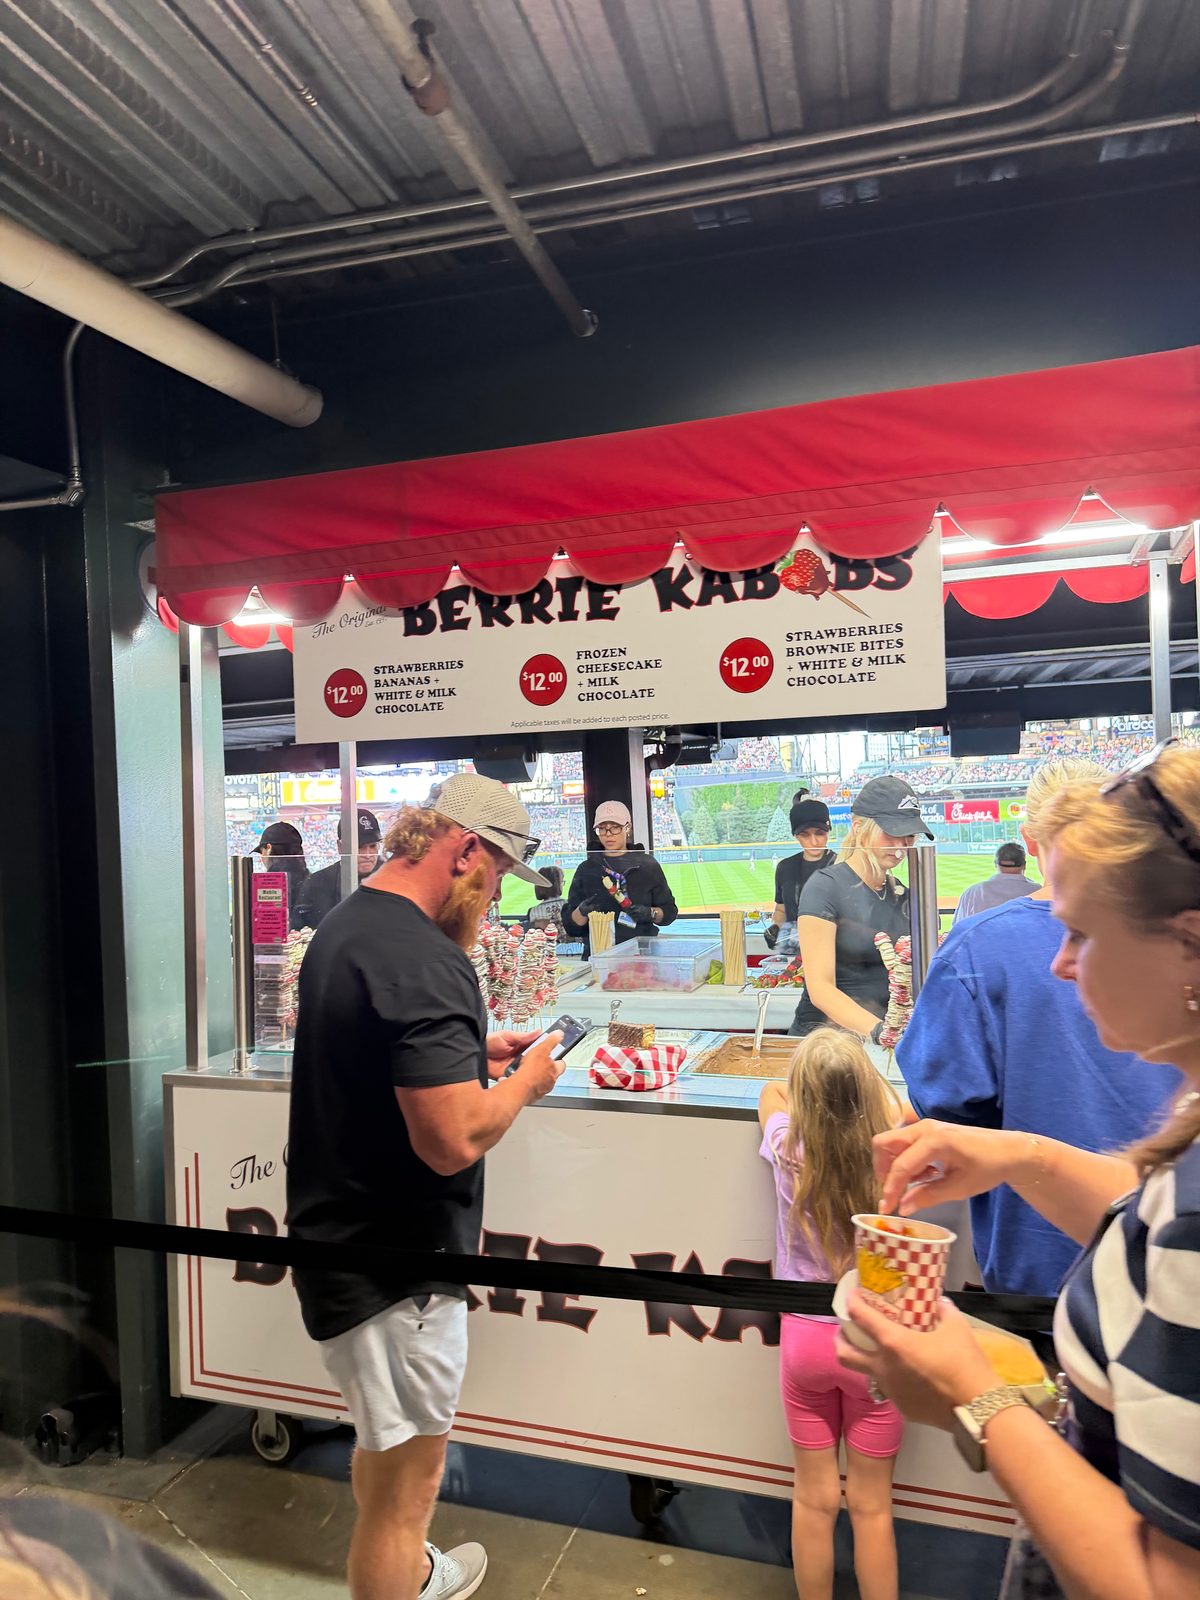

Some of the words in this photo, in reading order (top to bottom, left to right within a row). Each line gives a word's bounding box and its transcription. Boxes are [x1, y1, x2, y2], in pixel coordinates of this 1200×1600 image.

[398, 576, 624, 637] BERRIE
[312, 621, 335, 638] The
[785, 622, 904, 642] STRAWBERRIES
[576, 647, 627, 660] FROZEN
[786, 642, 856, 657] BROWNIE
[860, 638, 905, 651] BITES
[373, 660, 464, 675] STRAWBERRIES
[576, 659, 663, 674] CHEESECAKE
[723, 655, 770, 677] $12.00
[799, 658, 847, 671] WHITE
[852, 656, 863, 668] &
[868, 653, 907, 666] MILK
[374, 676, 431, 688] BANANAS
[522, 671, 563, 691] $12.00
[587, 676, 620, 687] MILK
[786, 671, 877, 687] CHOCOLATE
[326, 685, 364, 705] $12.00
[374, 690, 413, 701] WHITE
[415, 689, 425, 699] &
[427, 687, 457, 698] MILK
[577, 688, 656, 702] CHOCOLATE
[375, 702, 445, 714] CHOCOLATE
[510, 719, 543, 728] Applicable
[543, 719, 560, 727] taxes
[561, 718, 572, 726] will
[572, 717, 581, 725] be
[582, 715, 603, 725] added
[603, 715, 610, 723] to
[611, 714, 627, 723] each
[628, 713, 651, 722] posted
[652, 712, 670, 721] price.
[224, 775, 258, 785] OYOTA
[229, 1154, 277, 1190] The
